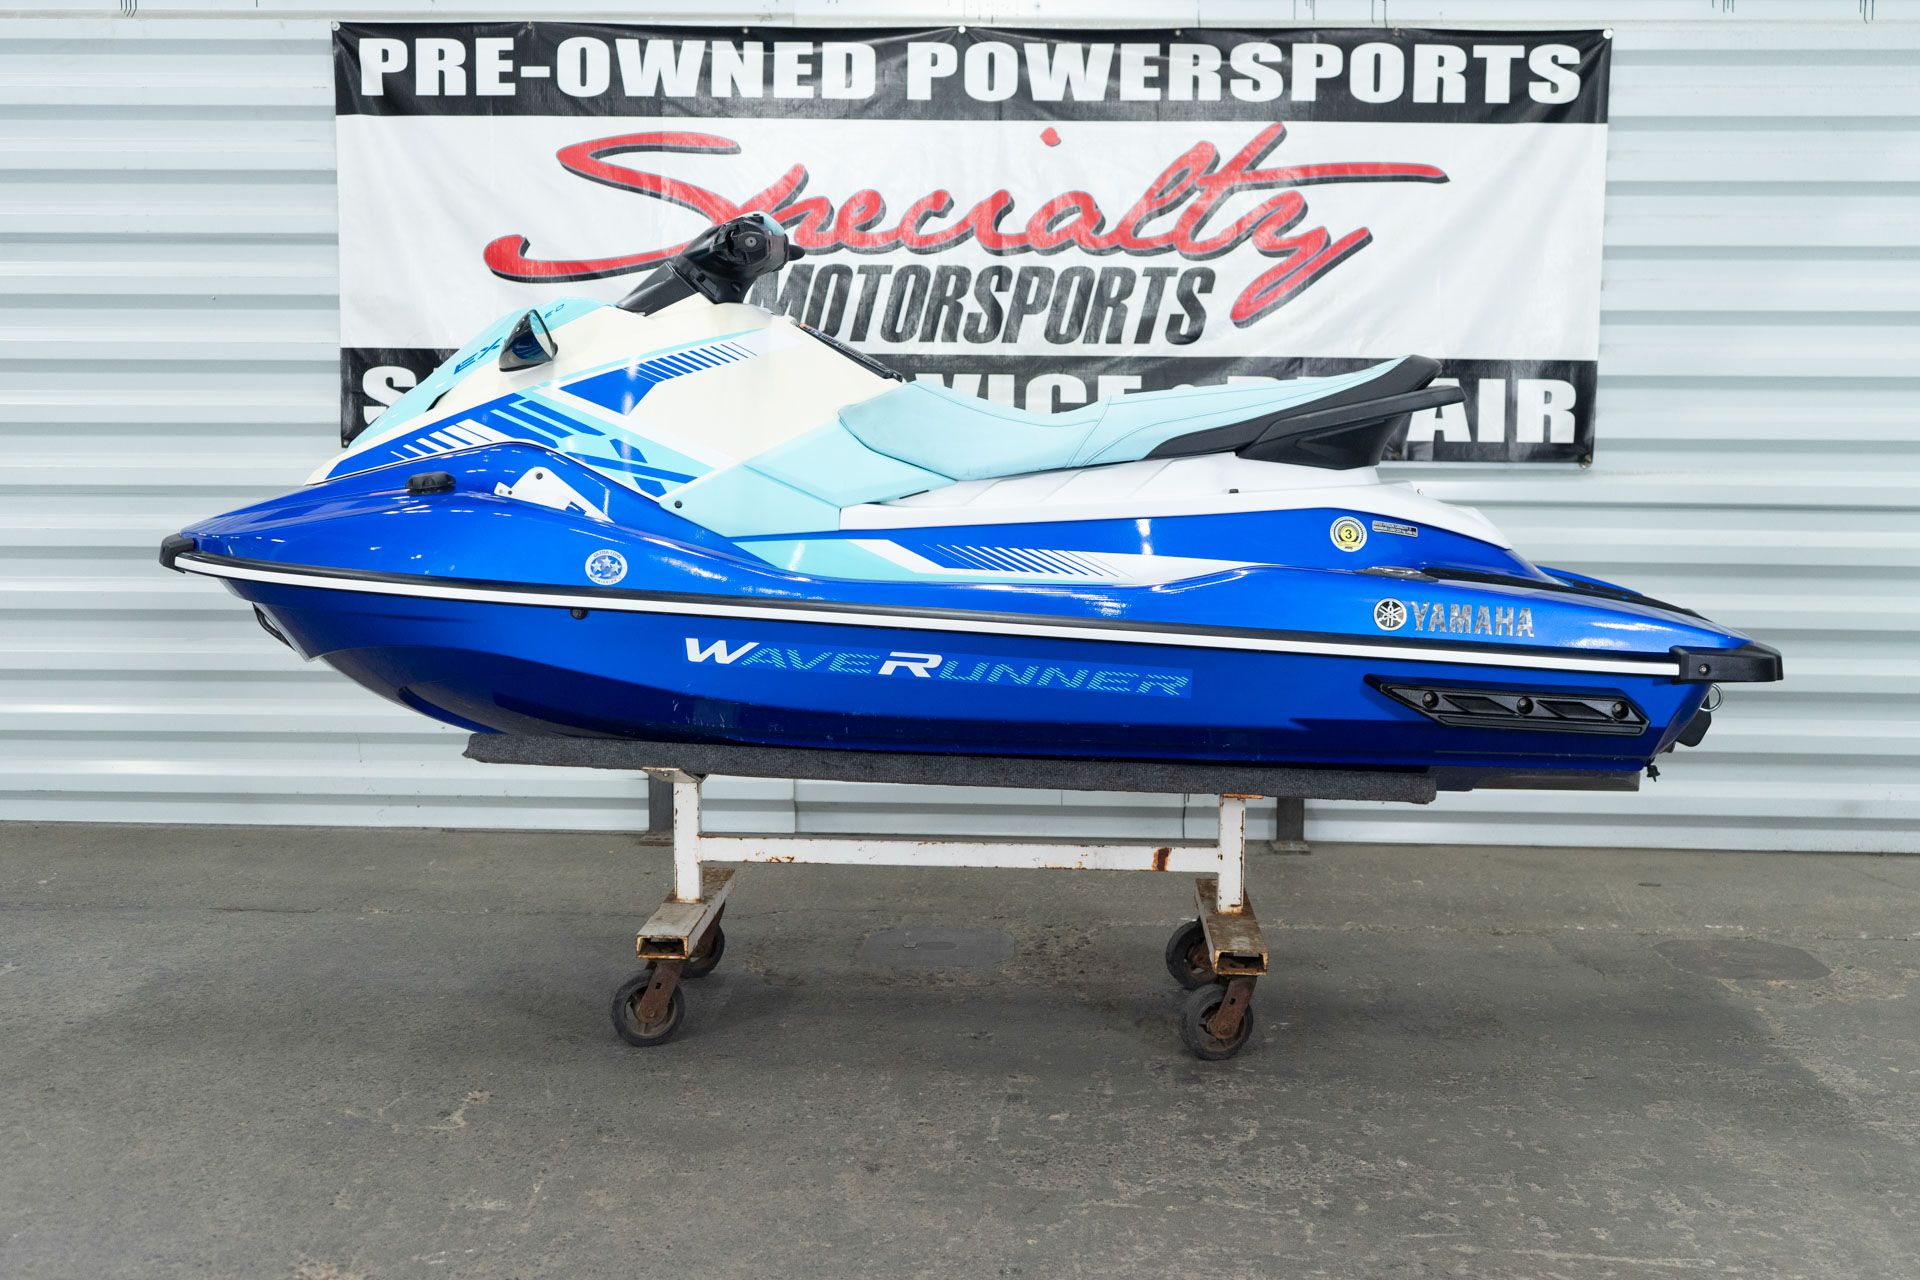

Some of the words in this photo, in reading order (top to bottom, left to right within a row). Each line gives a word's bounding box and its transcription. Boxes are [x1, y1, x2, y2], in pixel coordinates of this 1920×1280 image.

[358, 37, 876, 101] PRE-OWNED
[907, 41, 1581, 104] POWERSPORTS
[484, 122, 1450, 328] Specialty
[746, 263, 1216, 346] MOTORSPORTS
[1411, 601, 1535, 638] YAMAHA
[685, 637, 1190, 696] WAVERUNNER
